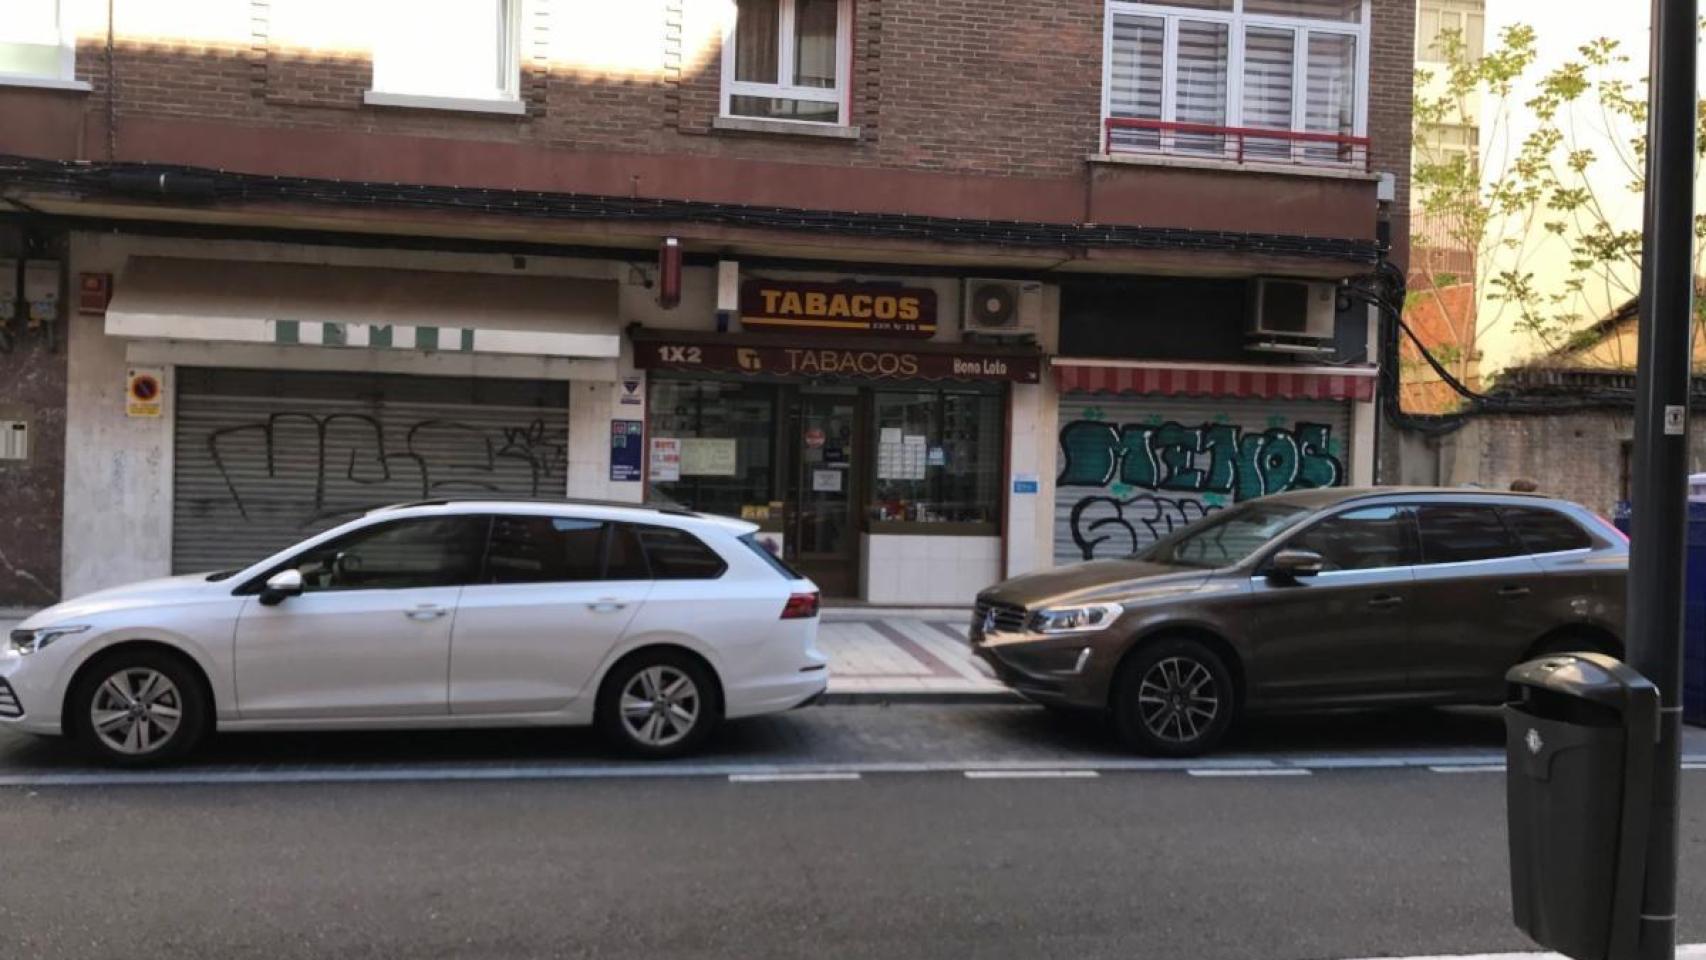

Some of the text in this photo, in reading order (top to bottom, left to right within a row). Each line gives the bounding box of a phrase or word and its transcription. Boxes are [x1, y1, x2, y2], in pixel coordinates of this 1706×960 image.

[760, 289, 920, 320] TABACOS
[658, 346, 702, 363] 1X2
[784, 348, 918, 375] TABACOS
